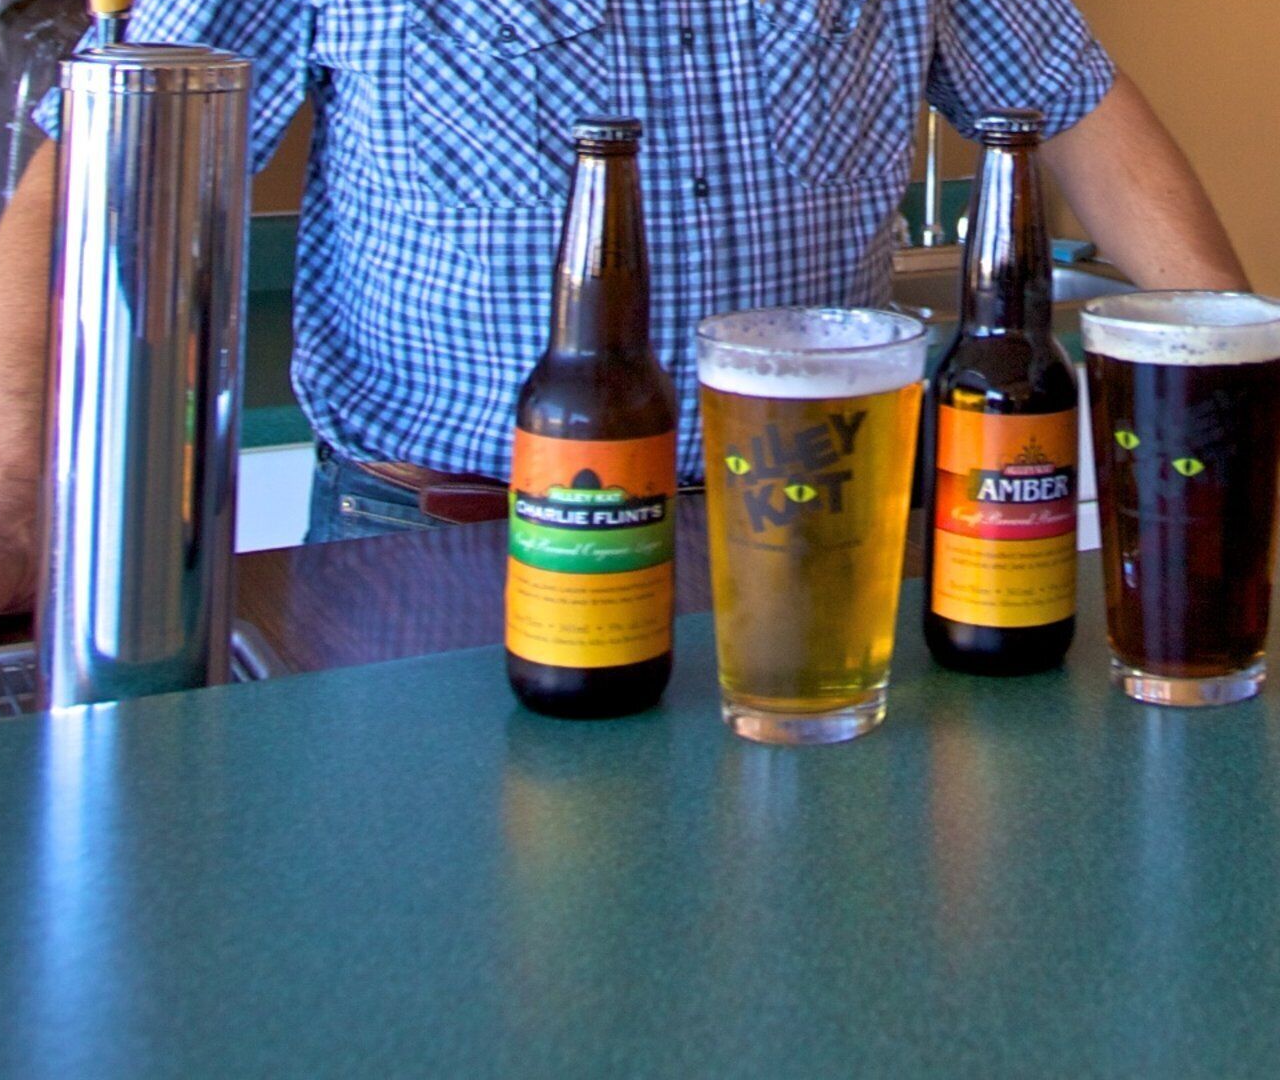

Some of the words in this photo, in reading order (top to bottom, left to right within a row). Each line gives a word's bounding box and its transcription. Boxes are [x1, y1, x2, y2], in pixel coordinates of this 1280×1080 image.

[726, 411, 868, 489] ALLEY
[744, 468, 854, 534] KAT
[976, 475, 1070, 502] AMBER
[515, 500, 590, 525] CHARLIE
